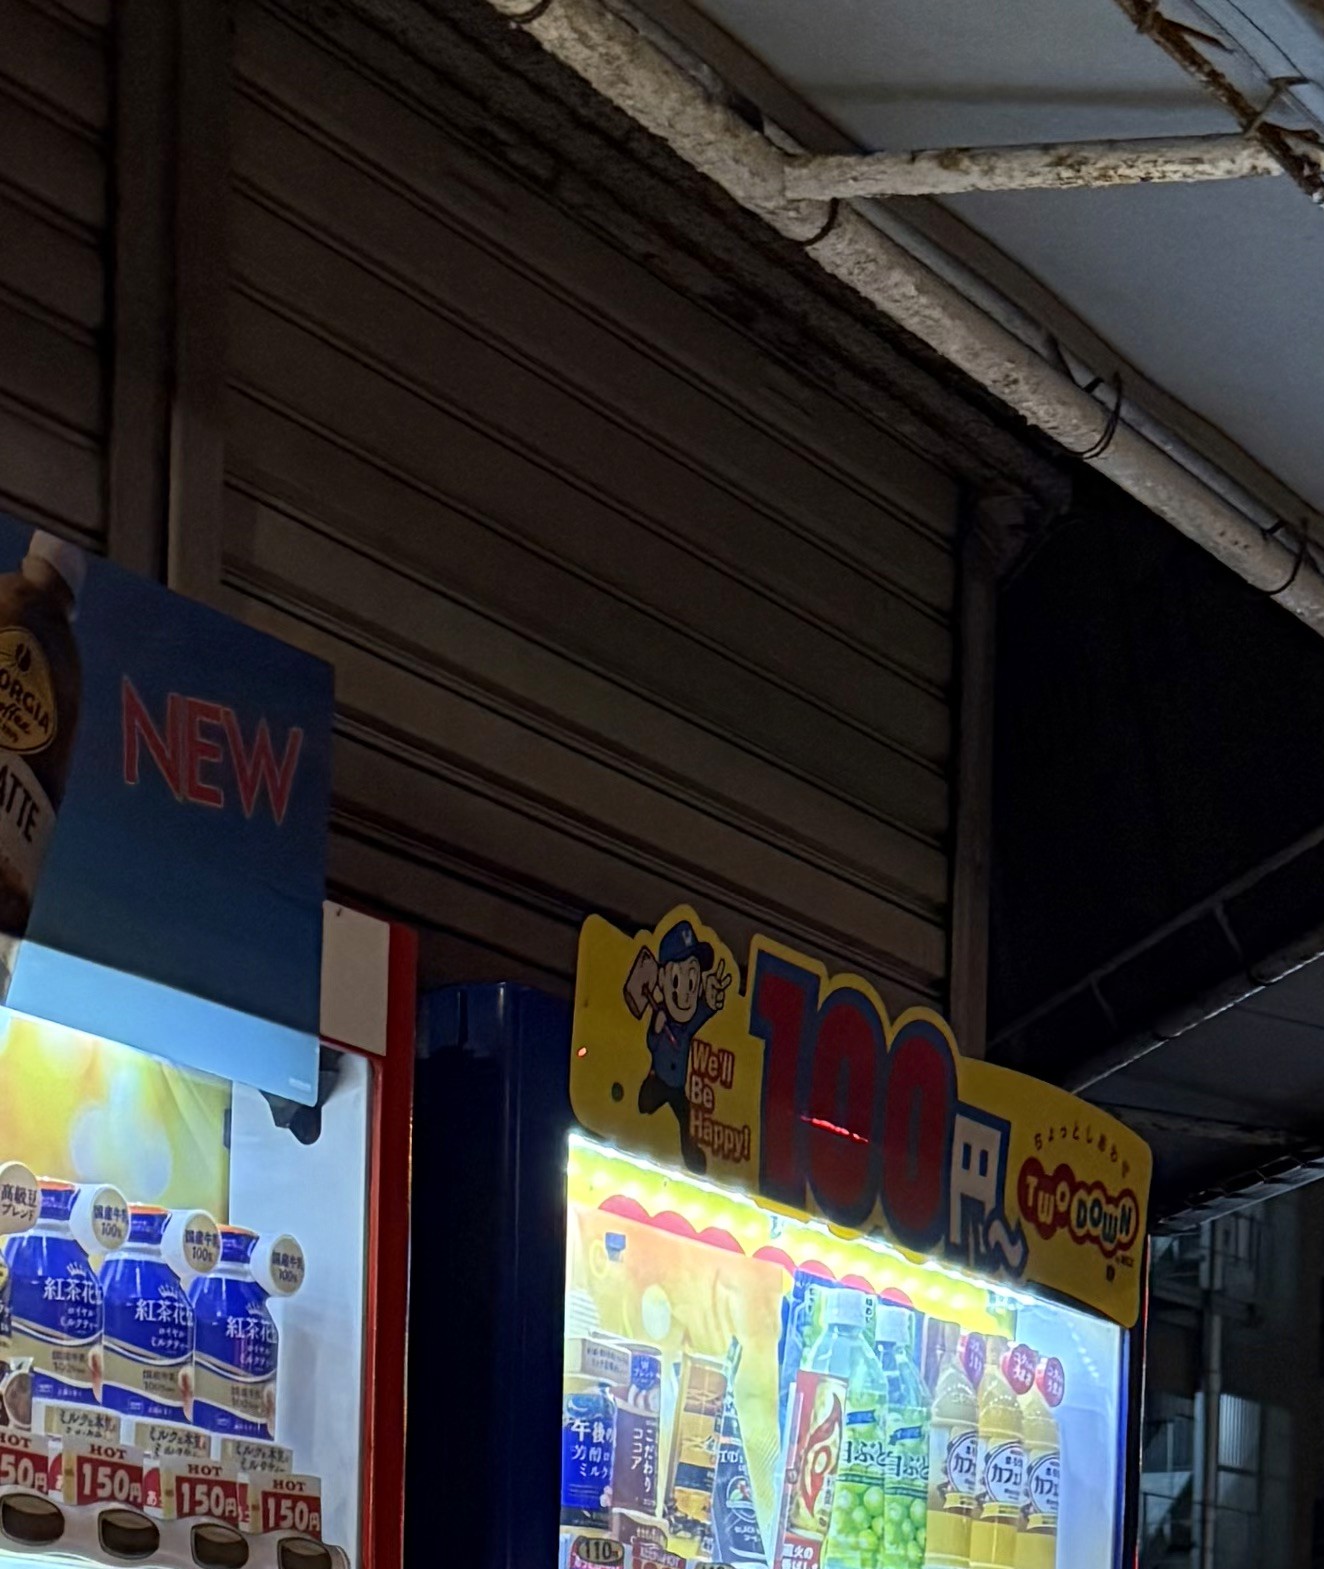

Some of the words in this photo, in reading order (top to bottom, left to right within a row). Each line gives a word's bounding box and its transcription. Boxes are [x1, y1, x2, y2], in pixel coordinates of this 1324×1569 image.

[121, 673, 303, 826] NEW
[692, 1039, 734, 1089] We'll
[690, 1075, 715, 1114] Be
[689, 1107, 751, 1161] Happy!
[90, 1443, 128, 1460] HOT
[631, 1427, 644, 1471] ココア
[643, 1424, 654, 1494] こだわり
[82, 1462, 142, 1503] 150円
[188, 1462, 223, 1477] HOT
[272, 1478, 306, 1492] HOT
[181, 1482, 239, 1518] 150円
[267, 1496, 320, 1533] 150円
